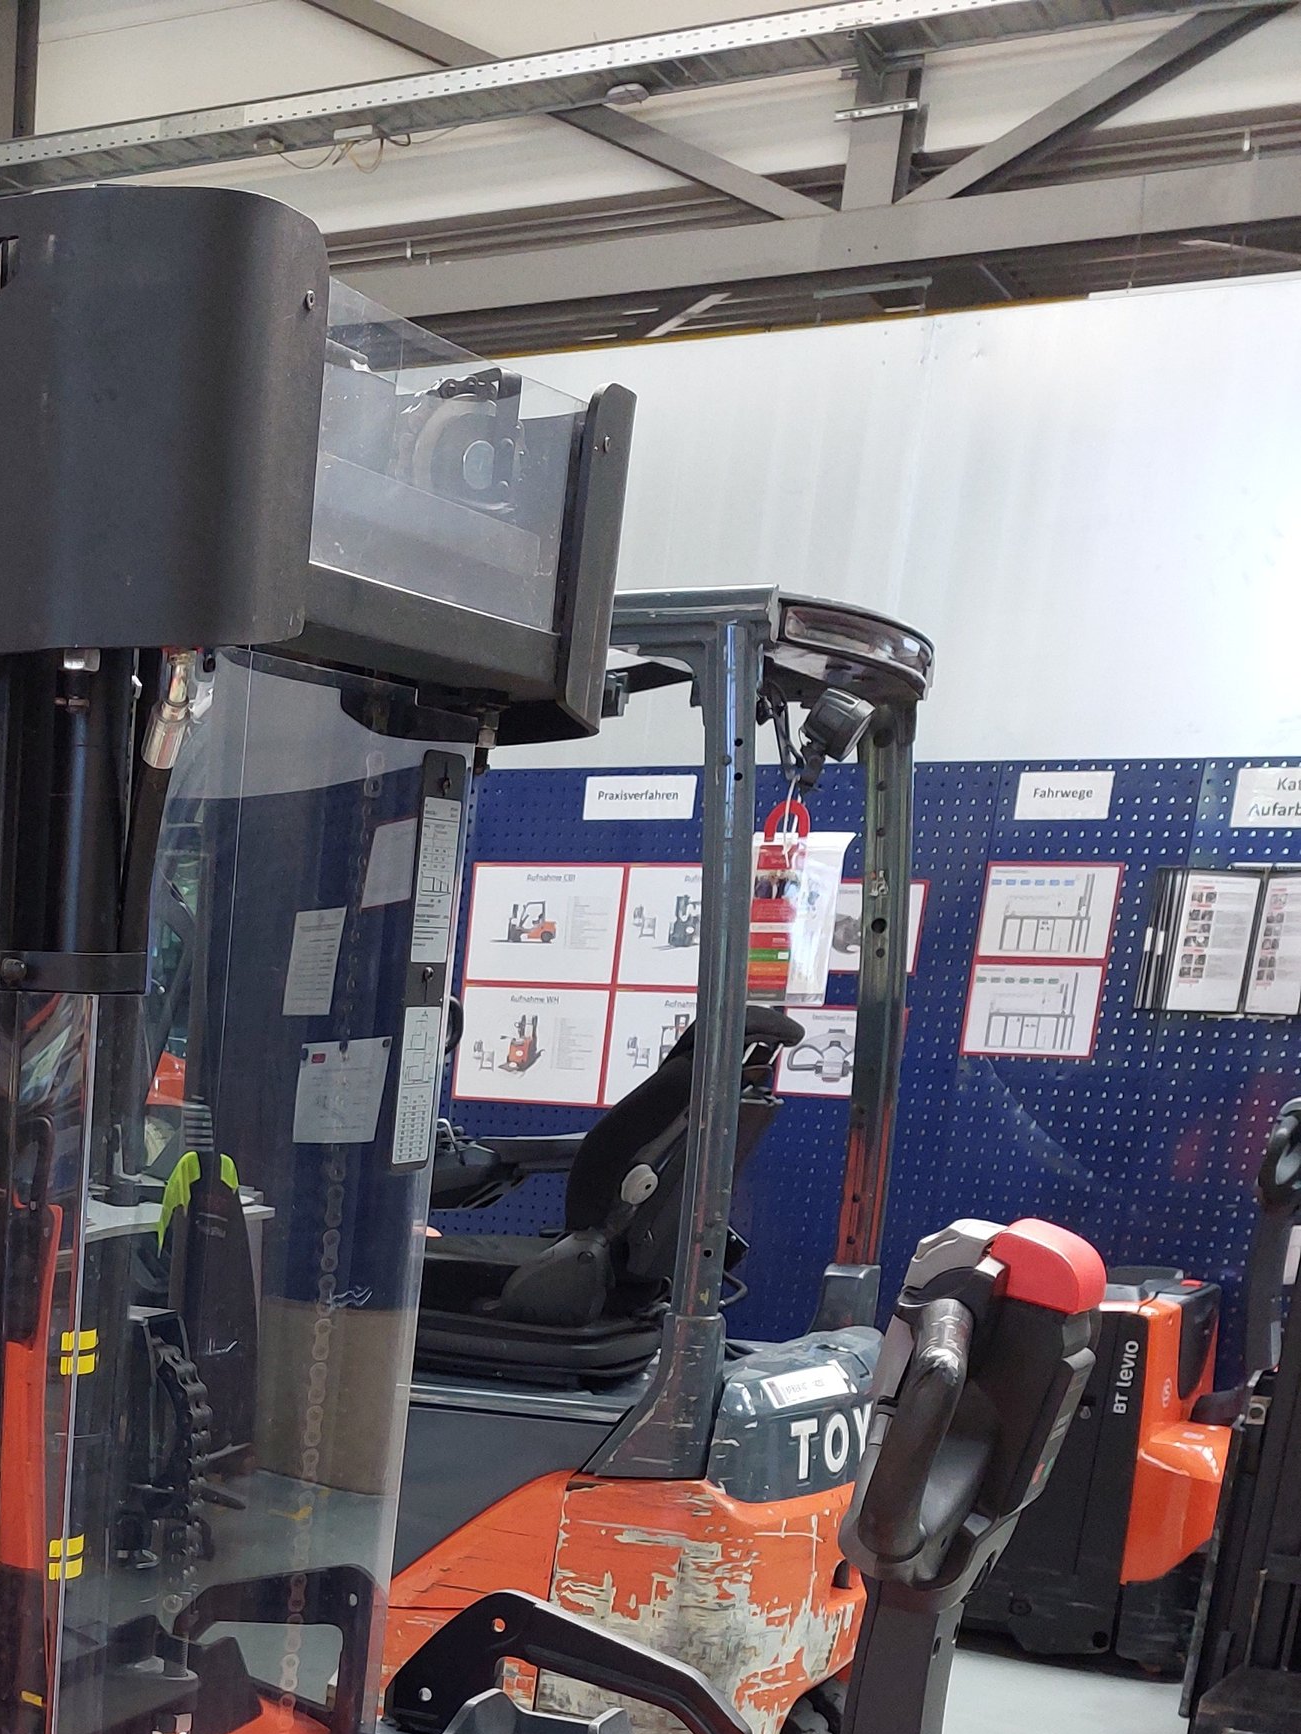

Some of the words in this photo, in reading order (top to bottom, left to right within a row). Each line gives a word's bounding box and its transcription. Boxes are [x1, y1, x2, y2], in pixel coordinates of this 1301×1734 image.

[597, 789, 679, 801] Praxisverfahren
[1032, 787, 1093, 800] Fahrwege
[1113, 1391, 1129, 1414] BT
